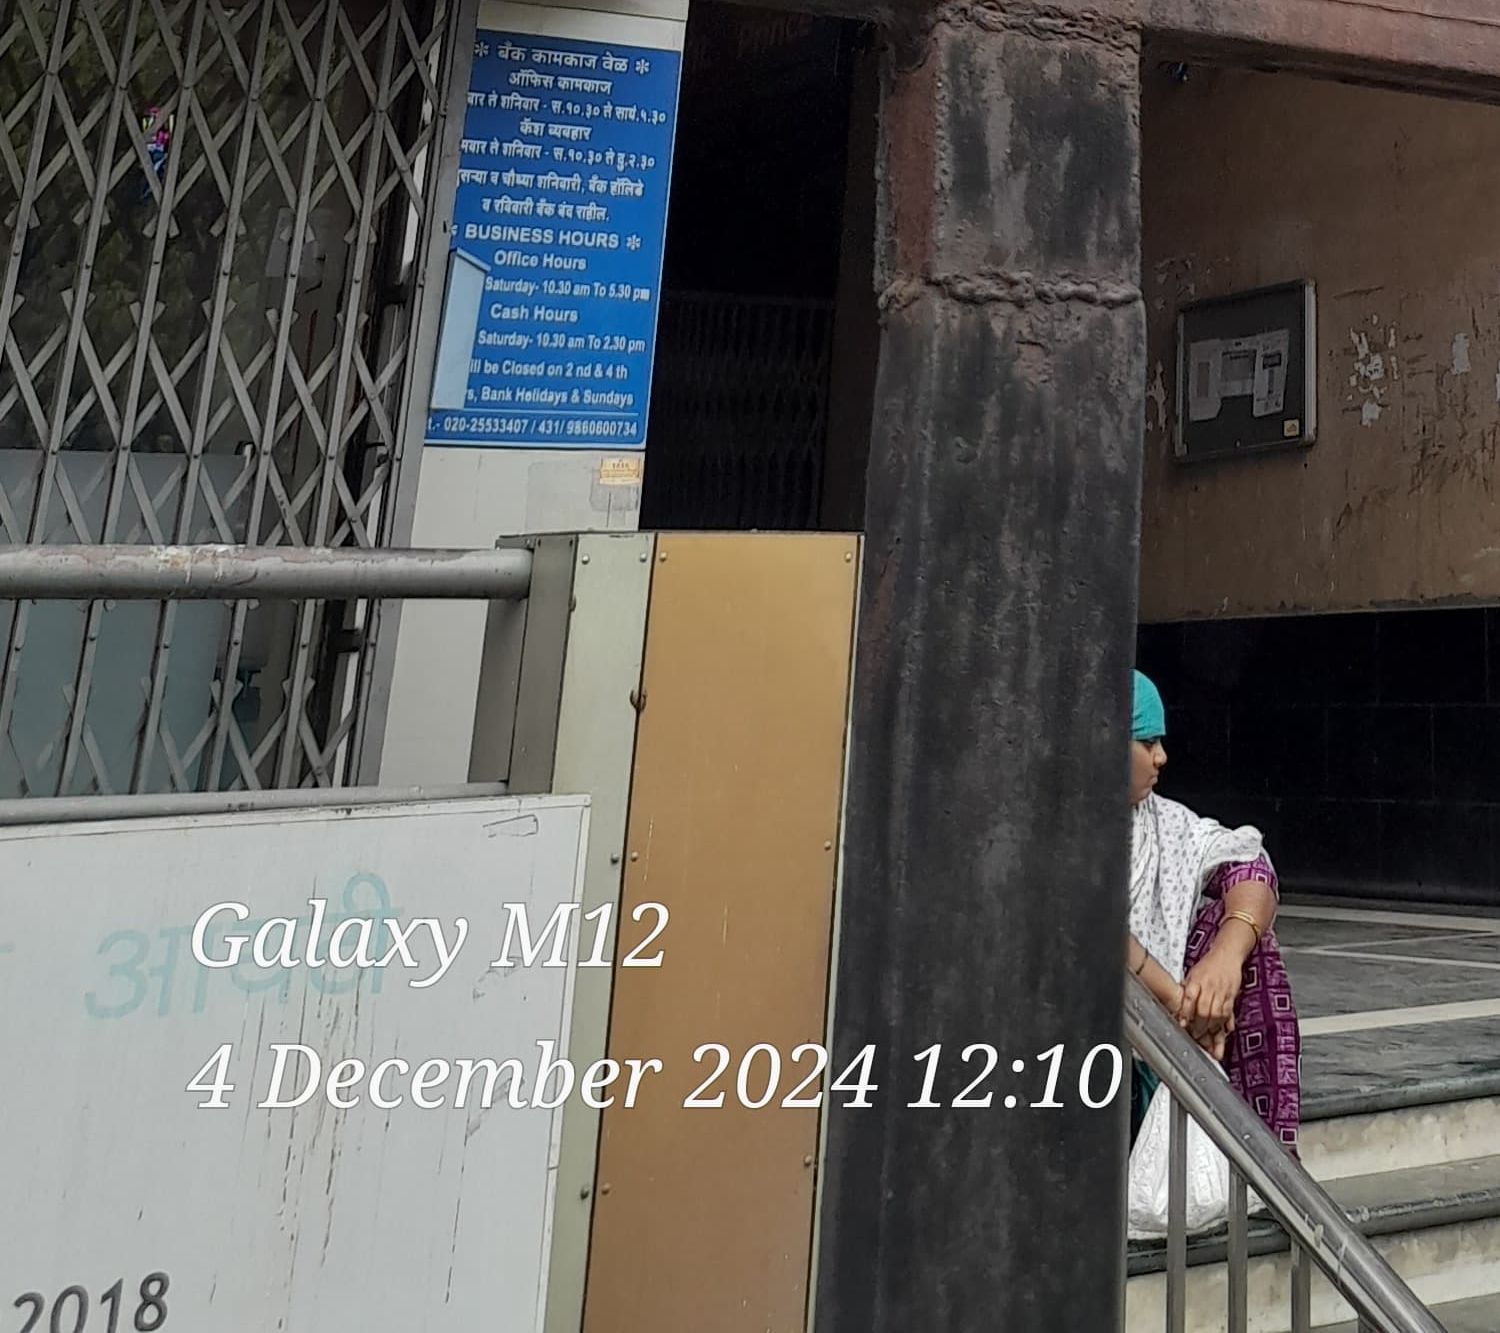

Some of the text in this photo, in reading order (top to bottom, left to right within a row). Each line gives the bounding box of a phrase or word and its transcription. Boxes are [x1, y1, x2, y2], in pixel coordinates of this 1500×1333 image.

[531, 49, 598, 70] कामकाज
[557, 76, 612, 95] कामकाज
[500, 91, 540, 112] शनिवार
[502, 139, 543, 160] शनिवार
[464, 223, 619, 249] BUSINESS HOURS
[494, 249, 587, 271] Office Hours
[542, 280, 572, 295] 10.30
[572, 284, 590, 297] am
[594, 283, 607, 297] To
[608, 284, 631, 299] 5.30
[632, 287, 651, 302] pm
[490, 302, 579, 323] Cash Hours
[536, 333, 566, 348] 10.30
[567, 336, 585, 349] am
[588, 334, 602, 349] To
[603, 335, 627, 351] 2.30
[627, 338, 646, 354] pm
[483, 359, 628, 379] be Closed on 2 nd 4 th
[480, 385, 634, 409] Bank Holidays & Sundays
[443, 417, 529, 434] 020-25533407
[13, 1271, 171, 1333] 2018
